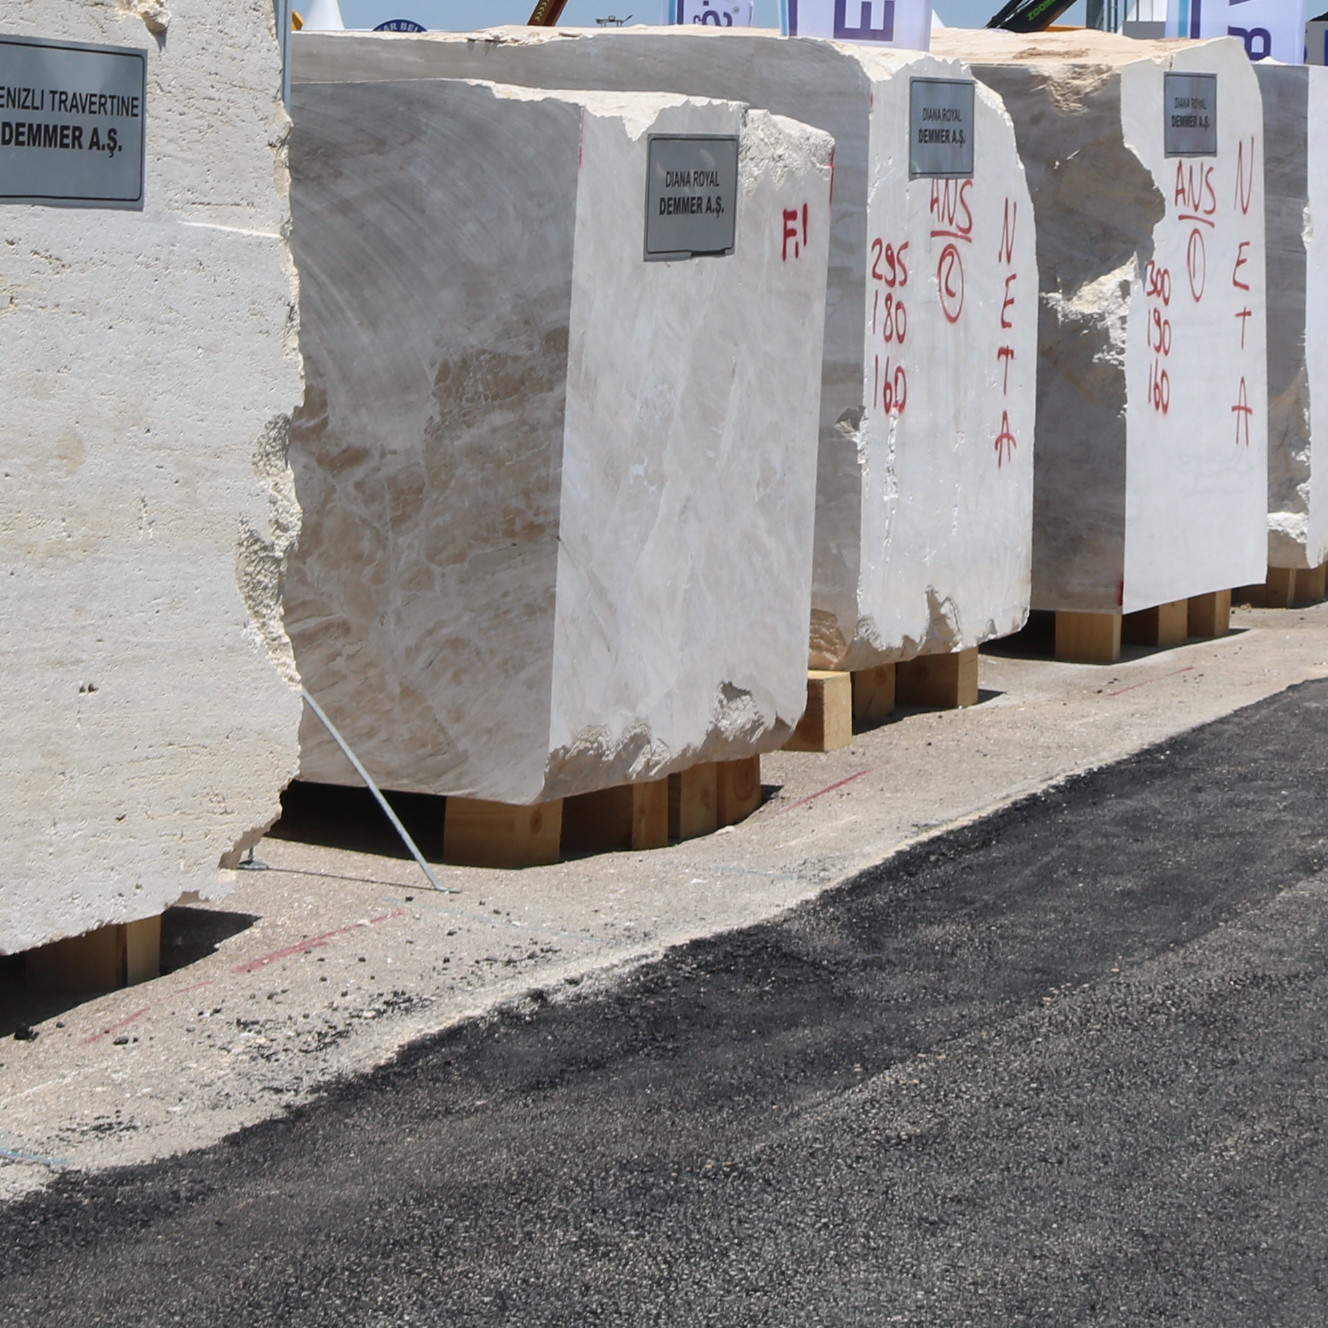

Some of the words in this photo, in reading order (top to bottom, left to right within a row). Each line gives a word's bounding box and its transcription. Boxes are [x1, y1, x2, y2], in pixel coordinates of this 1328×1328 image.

[49, 89, 139, 118] TRAVERTINE
[922, 107, 942, 122] DIANA
[943, 108, 962, 123] ROYAL
[1172, 113, 1196, 129] DEMMER
[1, 121, 83, 150] DEMMER
[88, 127, 122, 158] A.Ş.
[918, 128, 951, 145] DEMMER
[951, 129, 966, 148] A.Ş.
[665, 171, 691, 188] DIANA
[693, 170, 720, 188] ROYAL
[1174, 158, 1217, 216] ANS
[659, 197, 703, 216] DEMMER
[705, 196, 725, 218] A.Ş.
[872, 238, 909, 288] 295
[872, 288, 907, 344] 180
